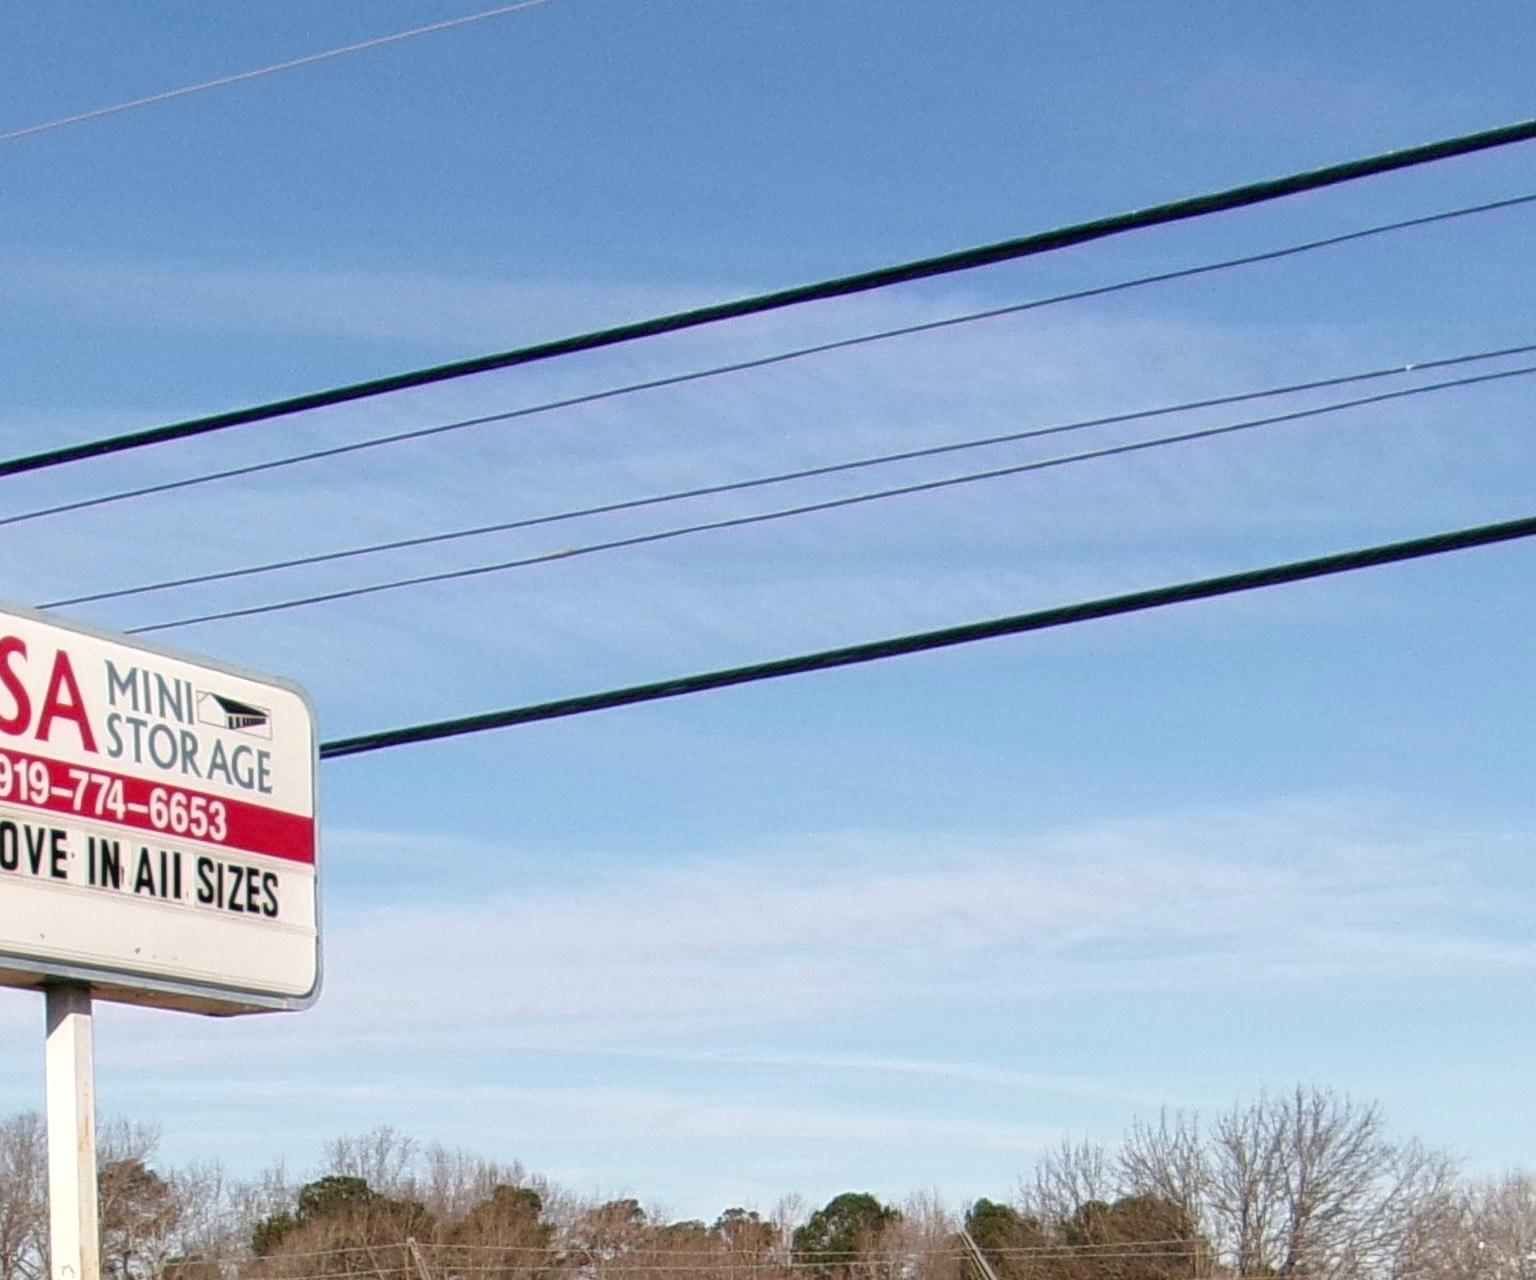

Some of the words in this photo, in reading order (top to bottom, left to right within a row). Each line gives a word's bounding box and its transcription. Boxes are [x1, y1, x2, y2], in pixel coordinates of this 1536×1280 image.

[104, 659, 195, 726] MINI
[107, 712, 272, 794] STORAGE
[88, 836, 120, 889] IN
[197, 856, 279, 918] SIZES
